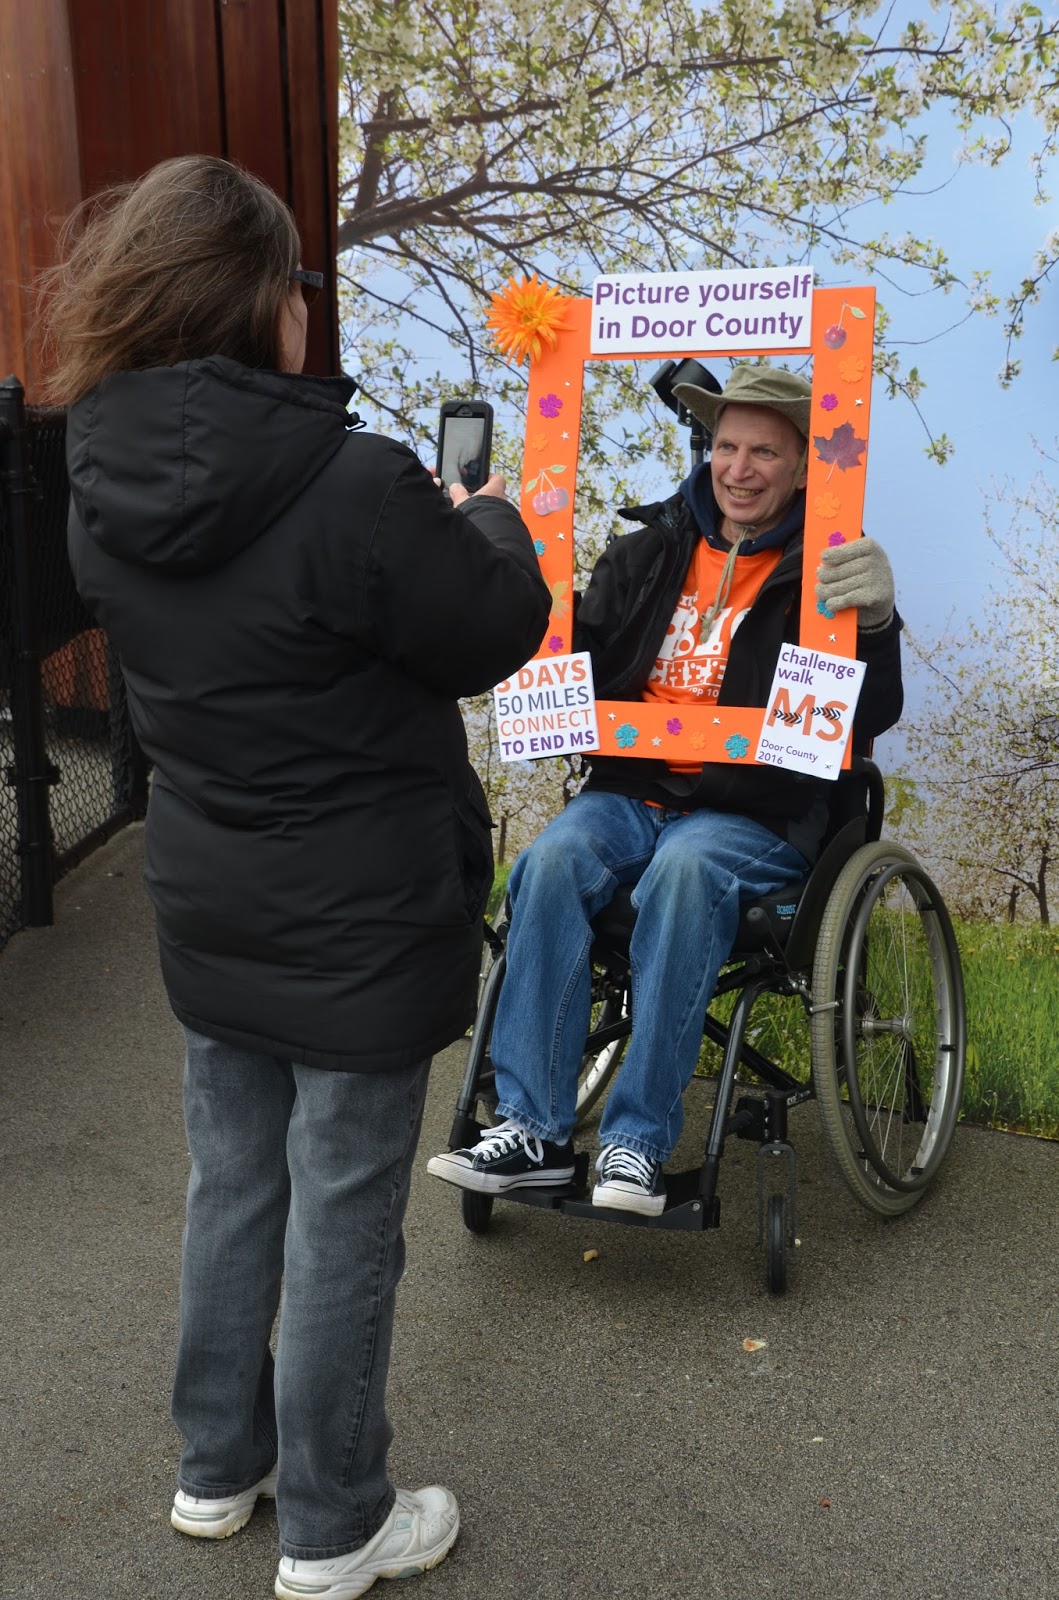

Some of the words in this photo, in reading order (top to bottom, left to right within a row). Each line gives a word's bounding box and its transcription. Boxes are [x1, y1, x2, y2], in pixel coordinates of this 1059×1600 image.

[595, 282, 690, 306] Picture
[698, 274, 812, 308] yourself
[598, 316, 621, 339] in
[631, 315, 697, 339] Door
[705, 312, 804, 340] County
[517, 659, 587, 690] DAYS
[777, 667, 814, 686] walk
[781, 648, 856, 680] challenge
[498, 695, 523, 716] 50
[528, 685, 590, 712] MILES
[766, 686, 849, 742] MS
[500, 708, 592, 737] CONNECT
[501, 740, 525, 756] TO
[529, 734, 565, 752] END
[569, 730, 595, 747] MS
[757, 750, 784, 765] 2016
[760, 738, 784, 752] Door
[785, 745, 819, 763] County
